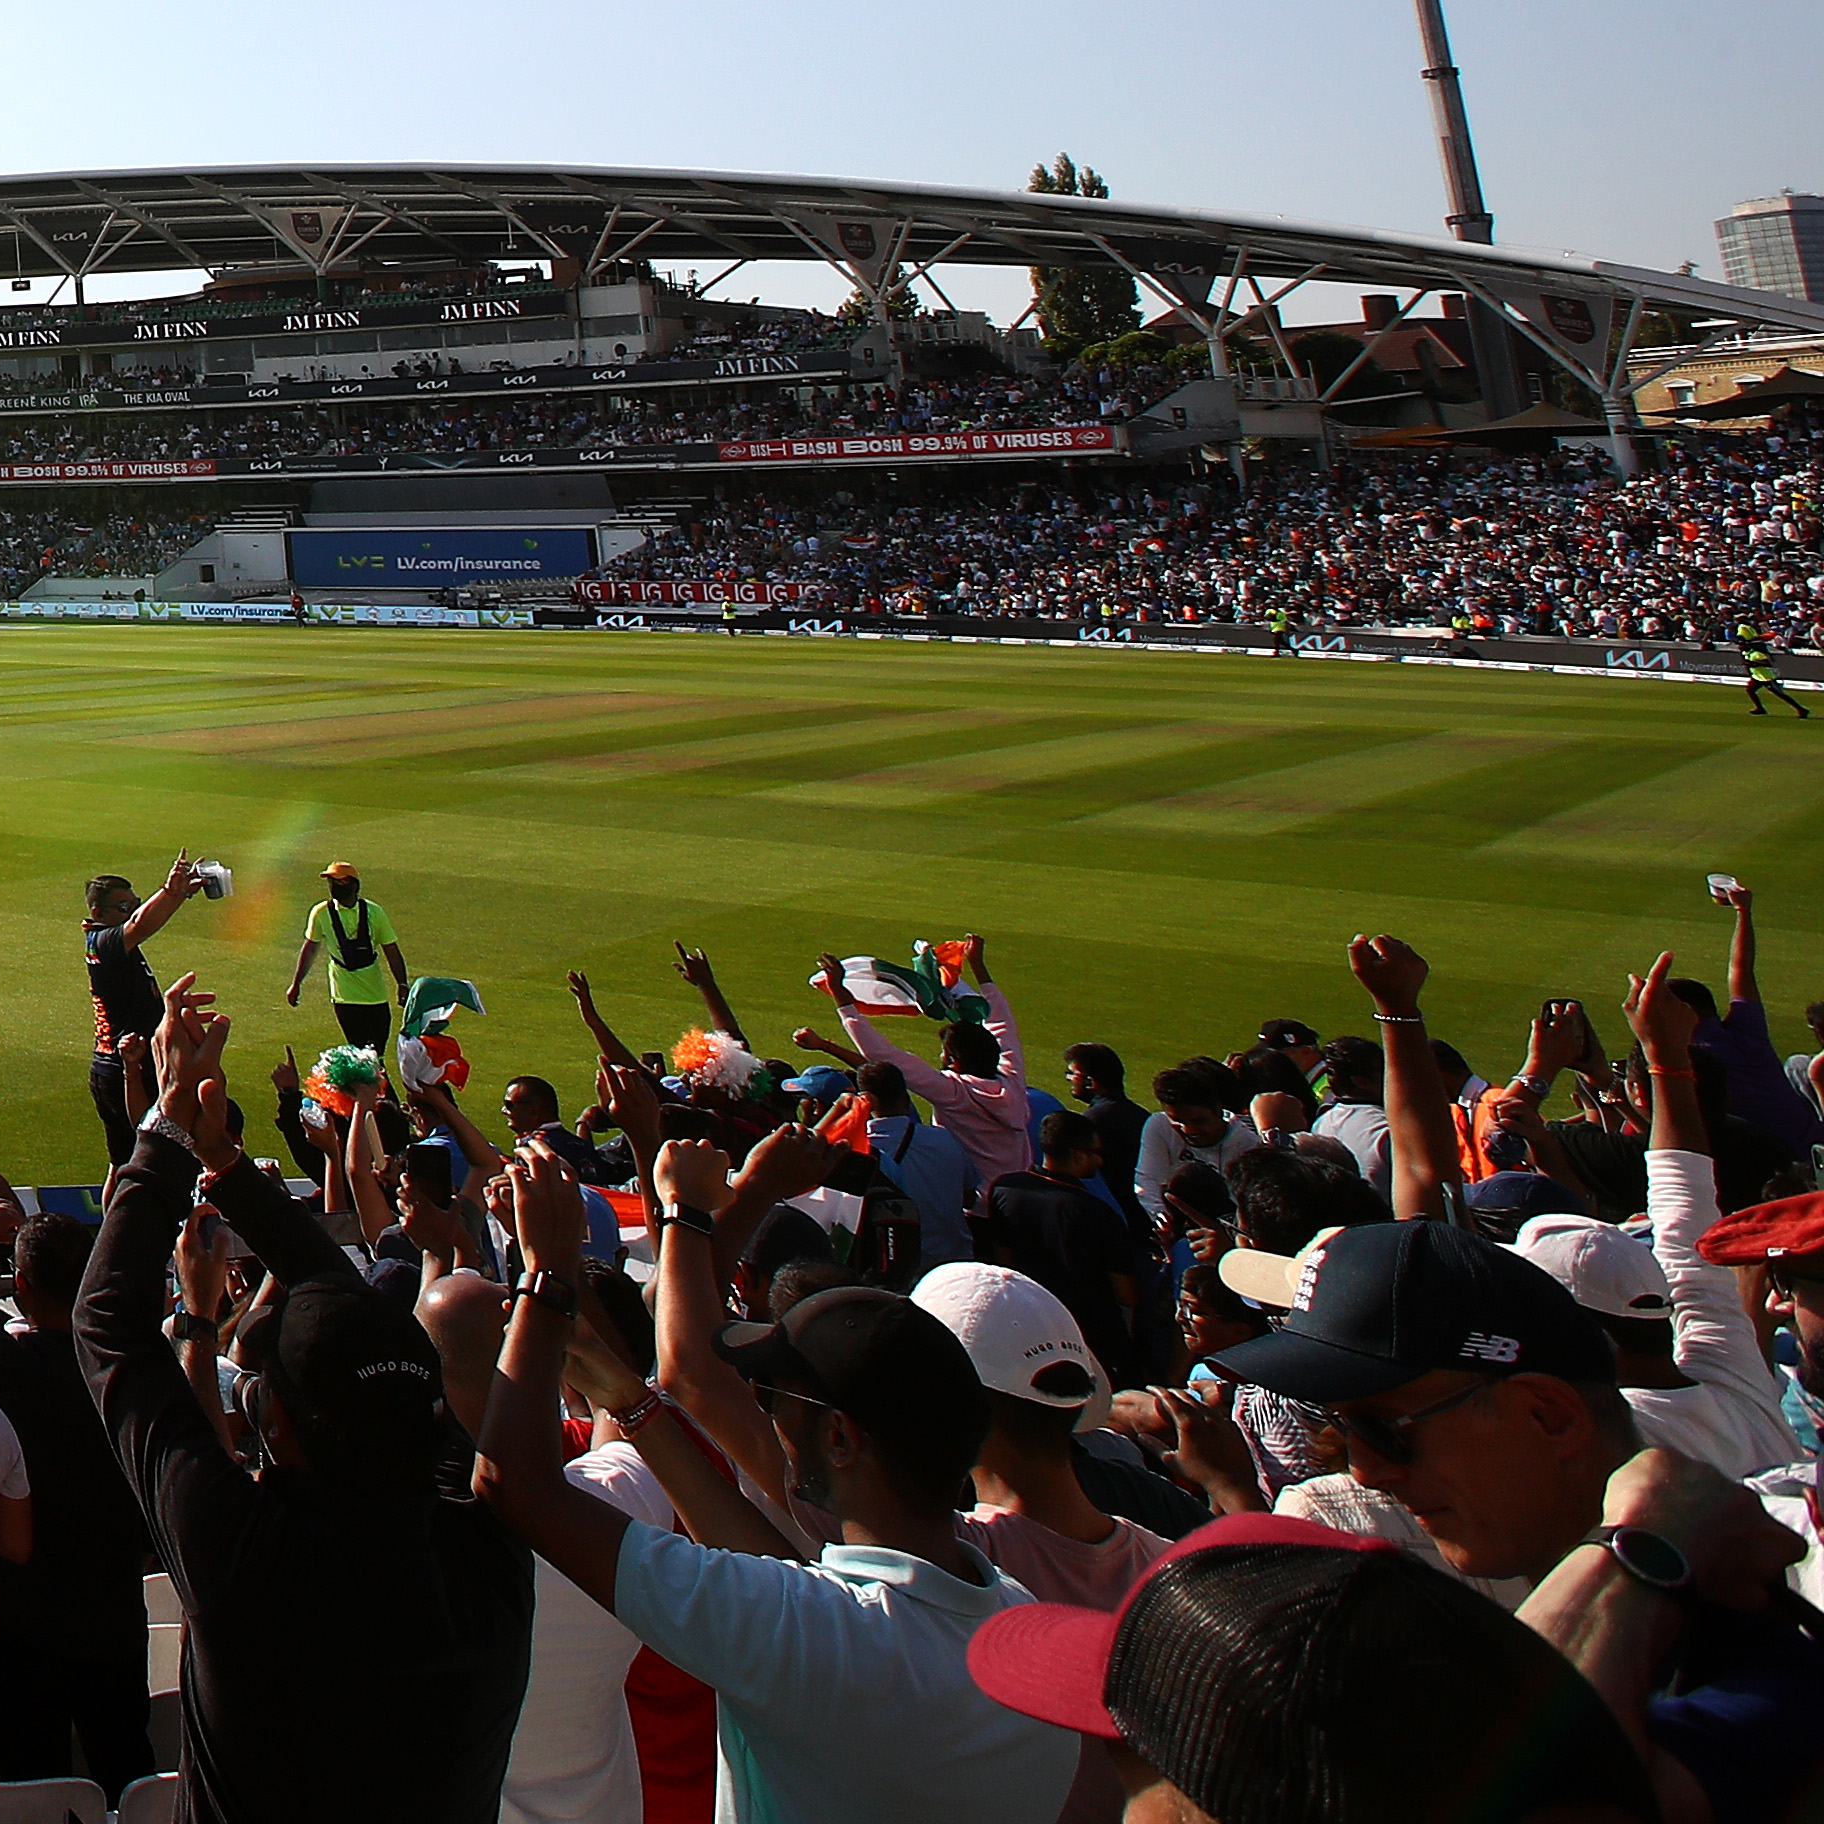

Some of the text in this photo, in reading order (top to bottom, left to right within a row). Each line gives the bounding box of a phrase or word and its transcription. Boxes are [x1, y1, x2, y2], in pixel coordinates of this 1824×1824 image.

[441, 301, 520, 320] JM FINN
[283, 312, 360, 330] JM FINN
[18, 330, 60, 345] FINN
[133, 322, 207, 339] JM FINN
[715, 356, 800, 376] JM FINN
[41, 396, 71, 407] KING
[123, 392, 190, 404] THE KIA OVAL
[793, 441, 837, 456] BASH
[843, 439, 903, 454] BOSH
[972, 434, 988, 448] OF
[993, 431, 1072, 447] VIRUSES
[13, 465, 59, 477] BOSH
[112, 464, 123, 474] OF
[128, 462, 187, 475] VIRUSES
[397, 556, 541, 572] LV.com/insurance
[190, 605, 293, 618] LV.com/insuran
[596, 614, 645, 628] KIA
[789, 619, 842, 632] KIA
[1289, 634, 1347, 651] KIA
[1606, 649, 1670, 669] KIA
[357, 1361, 430, 1380] HUGO BOSS
